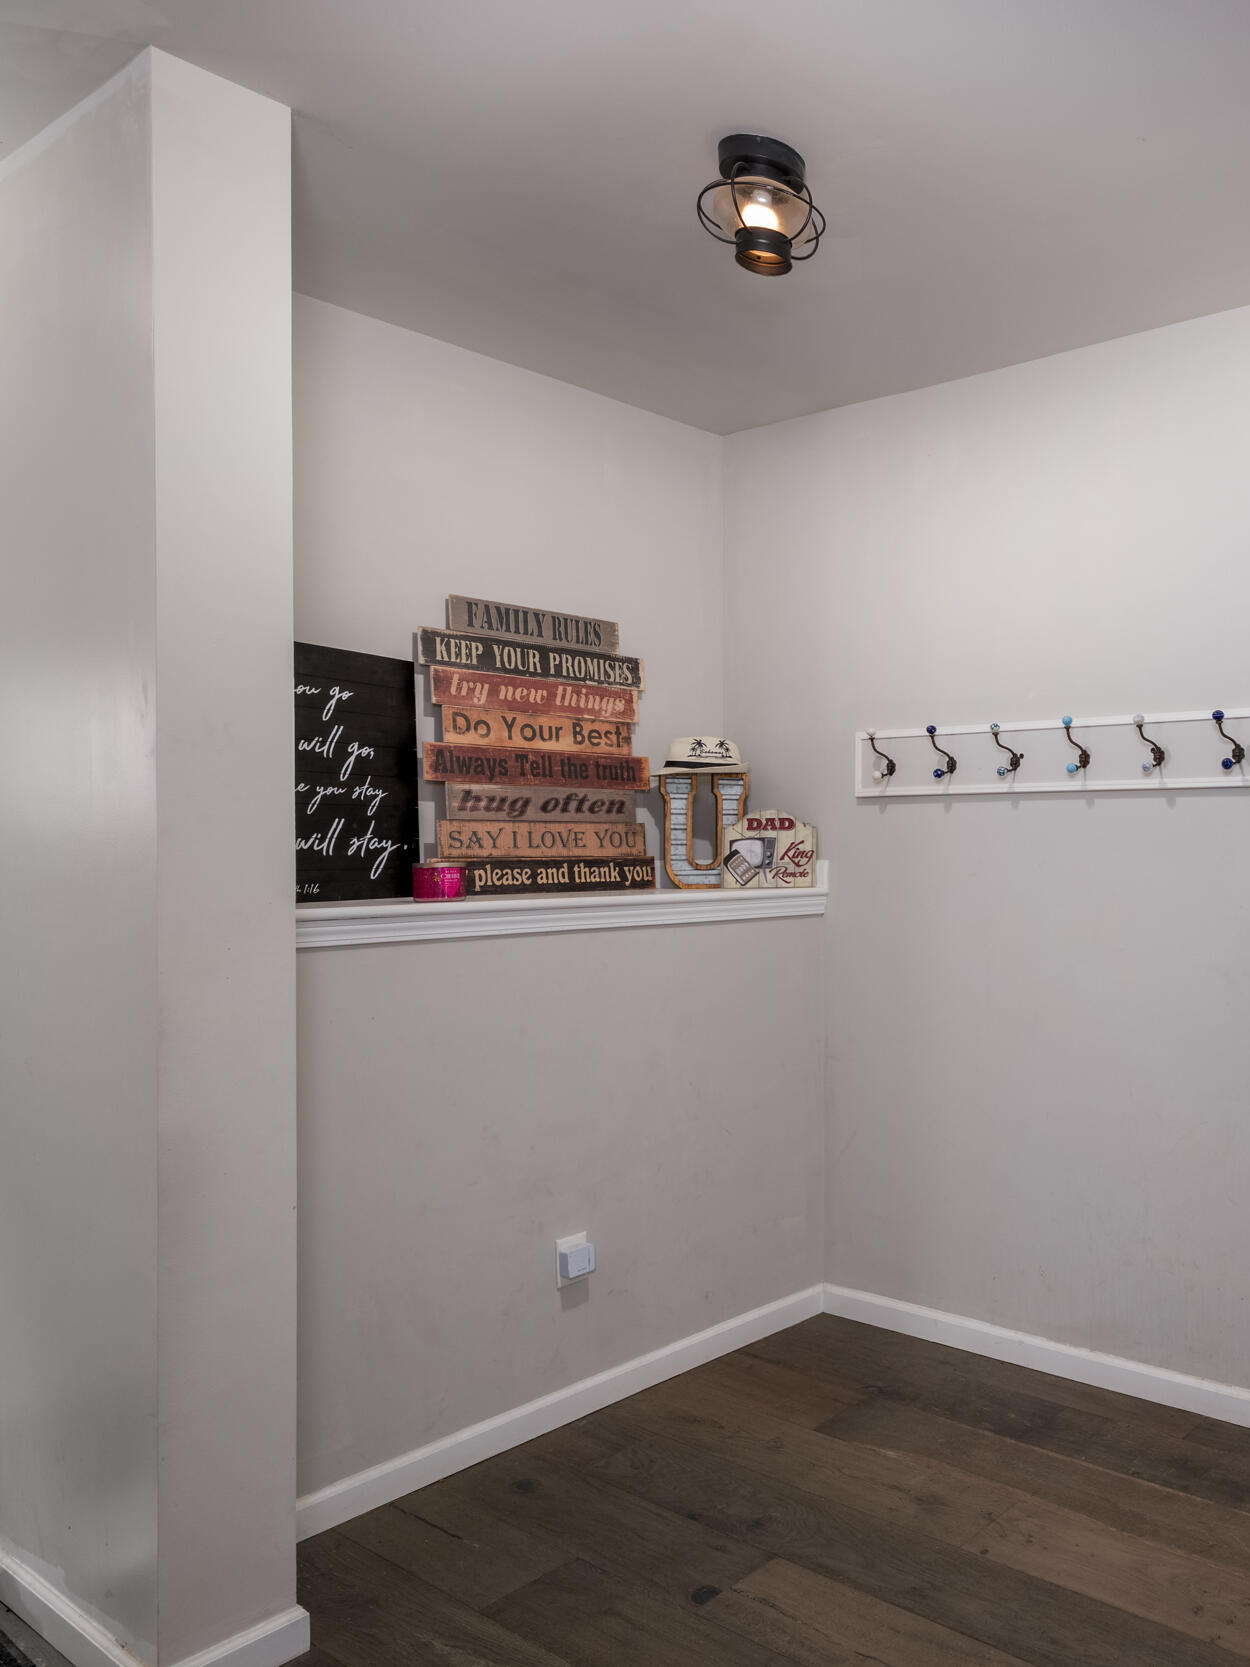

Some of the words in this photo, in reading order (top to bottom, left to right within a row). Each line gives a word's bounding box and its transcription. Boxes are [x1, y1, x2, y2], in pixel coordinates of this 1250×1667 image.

[466, 601, 546, 638] FAMILY
[551, 615, 602, 648] RULES
[435, 637, 484, 665] KEEP
[492, 644, 542, 673] YOUR
[549, 652, 633, 685] PROMISES
[295, 685, 322, 694] ou
[322, 686, 354, 721] go
[449, 674, 490, 705] try
[499, 682, 548, 705] new
[555, 685, 626, 716] things
[298, 725, 344, 758] will
[452, 711, 491, 738] Do
[501, 715, 563, 742] Your
[572, 722, 622, 749] Best
[433, 749, 509, 782] Always
[515, 754, 552, 779] Tell
[560, 757, 590, 780] the
[594, 760, 637, 782] truth
[307, 785, 347, 815] you
[351, 775, 389, 816] stay
[456, 789, 532, 818] hug
[539, 793, 626, 815] often
[295, 818, 345, 856] will
[449, 828, 504, 849] SAY
[512, 831, 519, 848] I
[527, 829, 587, 849] LOVE
[594, 829, 637, 849] YOU
[746, 817, 796, 832] DAD
[779, 840, 815, 867] King
[474, 864, 533, 892] please
[536, 862, 570, 887] and
[573, 863, 621, 884] thank
[623, 865, 652, 886] you
[769, 865, 809, 884] Remote
